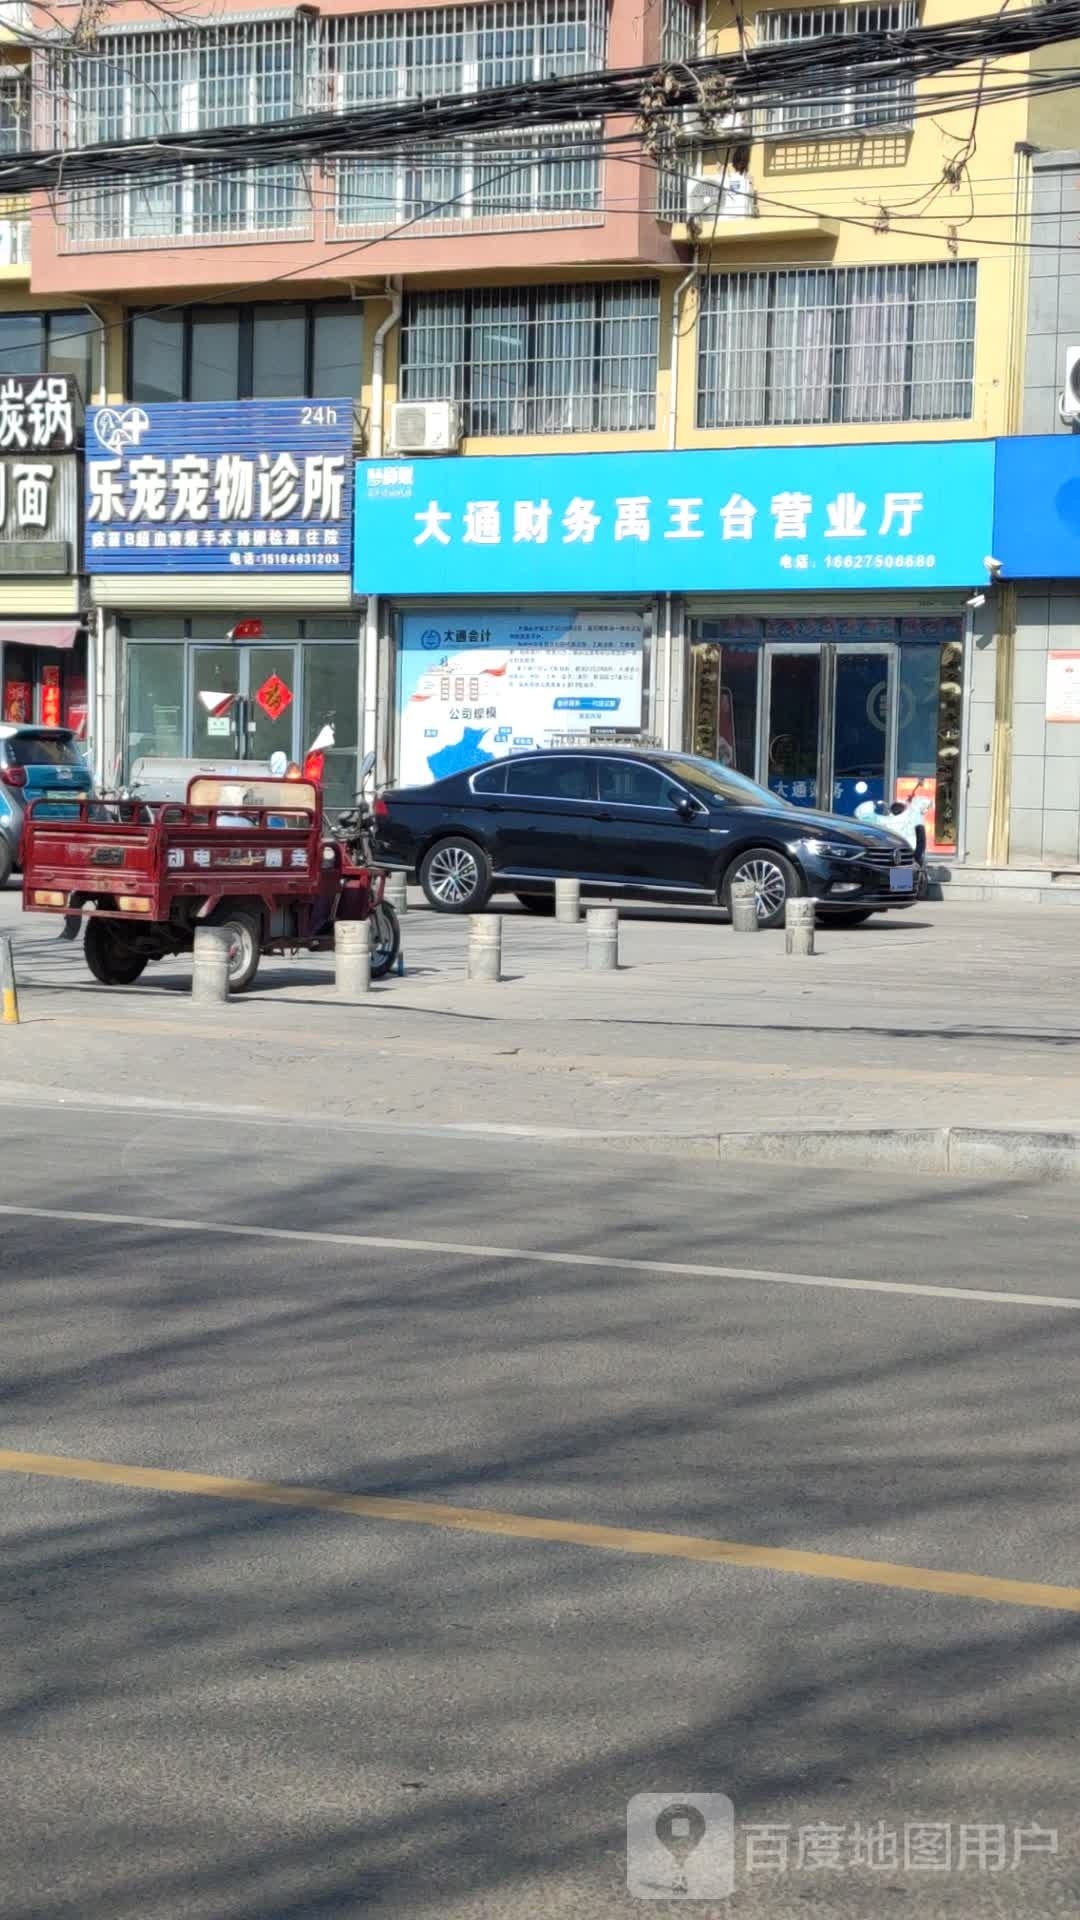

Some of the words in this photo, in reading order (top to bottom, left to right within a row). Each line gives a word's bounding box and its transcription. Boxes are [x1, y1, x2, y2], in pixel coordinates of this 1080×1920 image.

[0, 378, 73, 447] 炭锅
[301, 406, 338, 425] 24h
[88, 452, 345, 522] 乐宠宠物诊所
[413, 491, 924, 547] 大通财务禹王台营业厅
[443, 629, 491, 643] 大通会计
[449, 706, 497, 720] 公司规模
